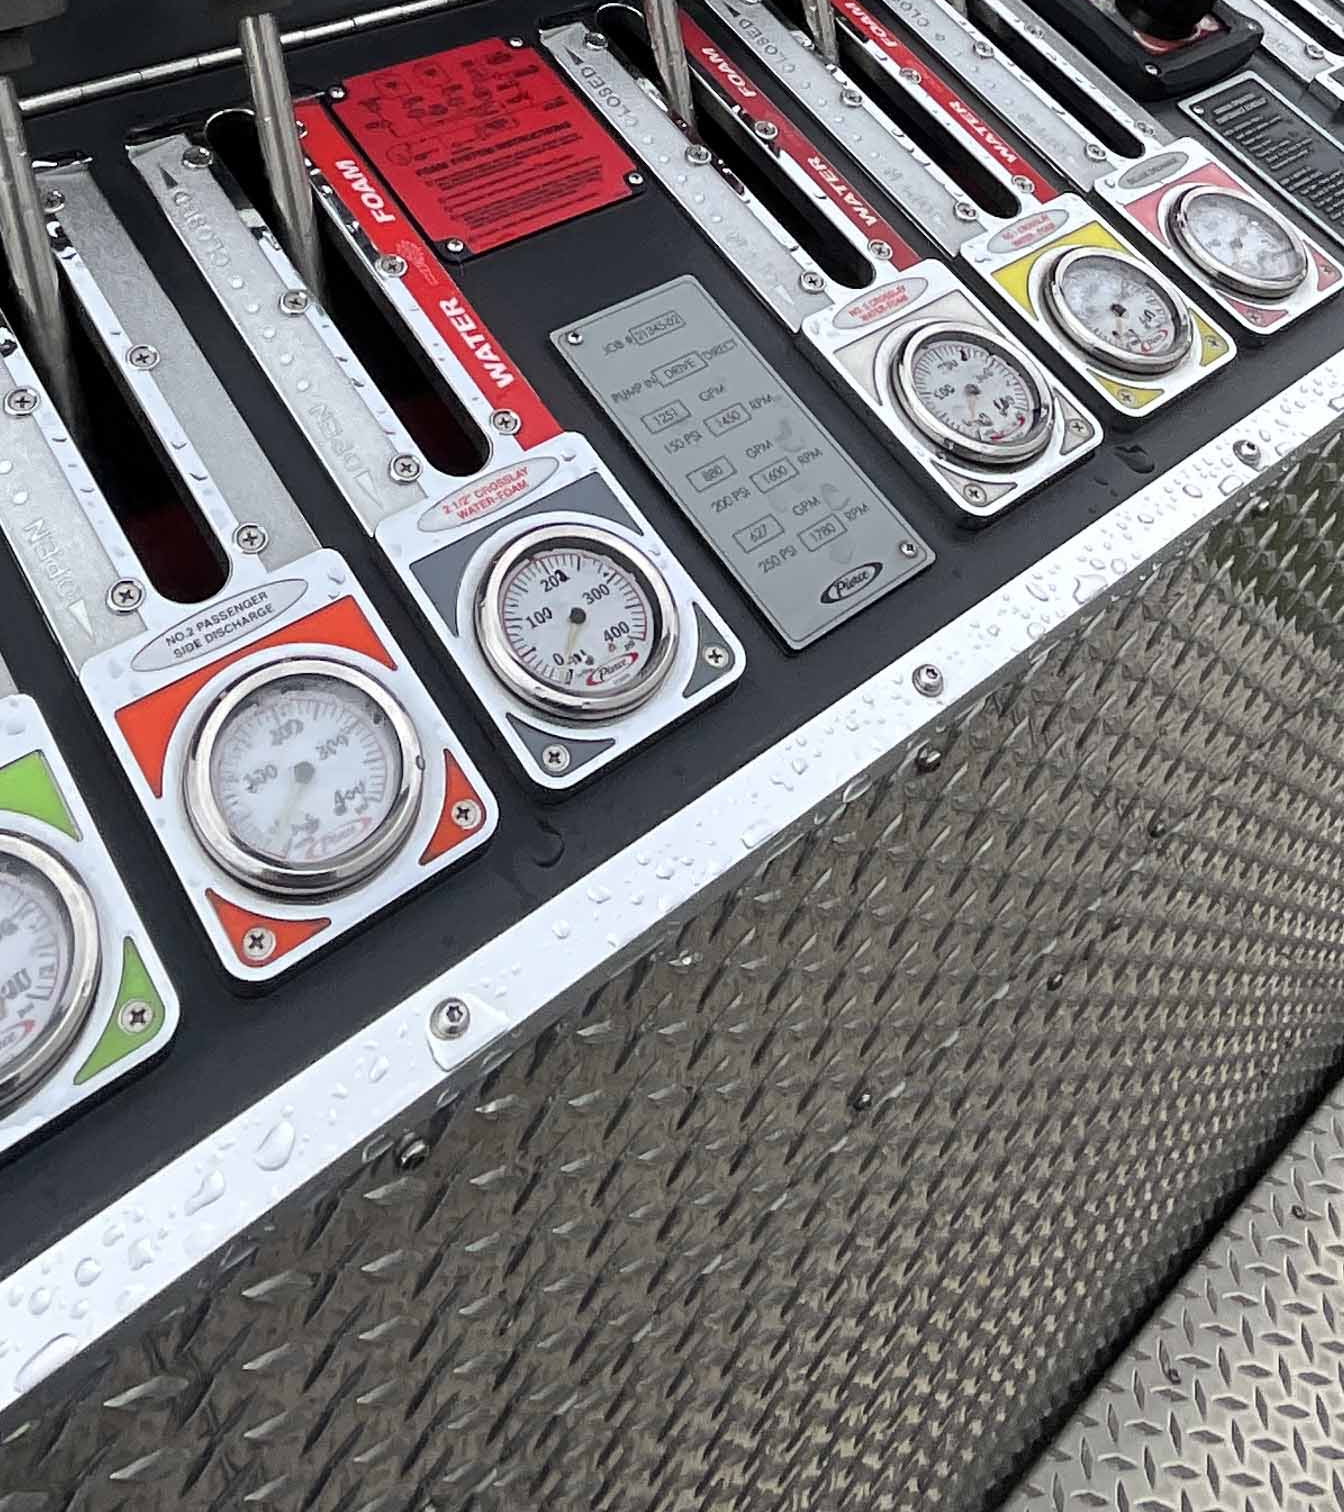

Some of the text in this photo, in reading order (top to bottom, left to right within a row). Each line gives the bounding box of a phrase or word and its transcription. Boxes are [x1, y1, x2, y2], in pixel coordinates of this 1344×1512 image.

[844, 1, 898, 48] FOAM
[701, 47, 758, 98] FOAM
[948, 99, 1019, 164] WATER
[334, 158, 395, 224] FOAM
[807, 155, 878, 227] WATER
[173, 190, 233, 269] CLOSED
[438, 296, 516, 389] WATER
[610, 381, 643, 404] PUMP
[663, 358, 696, 380] DRIVE
[744, 439, 774, 459] GPM
[796, 447, 824, 466] RPM
[441, 504, 453, 515] 2
[473, 466, 529, 499] CROSSLAY
[791, 495, 821, 517] GPM
[757, 554, 782, 574] 250
[843, 502, 870, 522] RPM
[195, 590, 269, 633] PASSENGER
[582, 583, 611, 605] 300
[173, 603, 275, 659] SIDE DISCHARGE
[525, 606, 554, 630] 100
[603, 620, 631, 643] 400
[552, 652, 565, 667] 0
